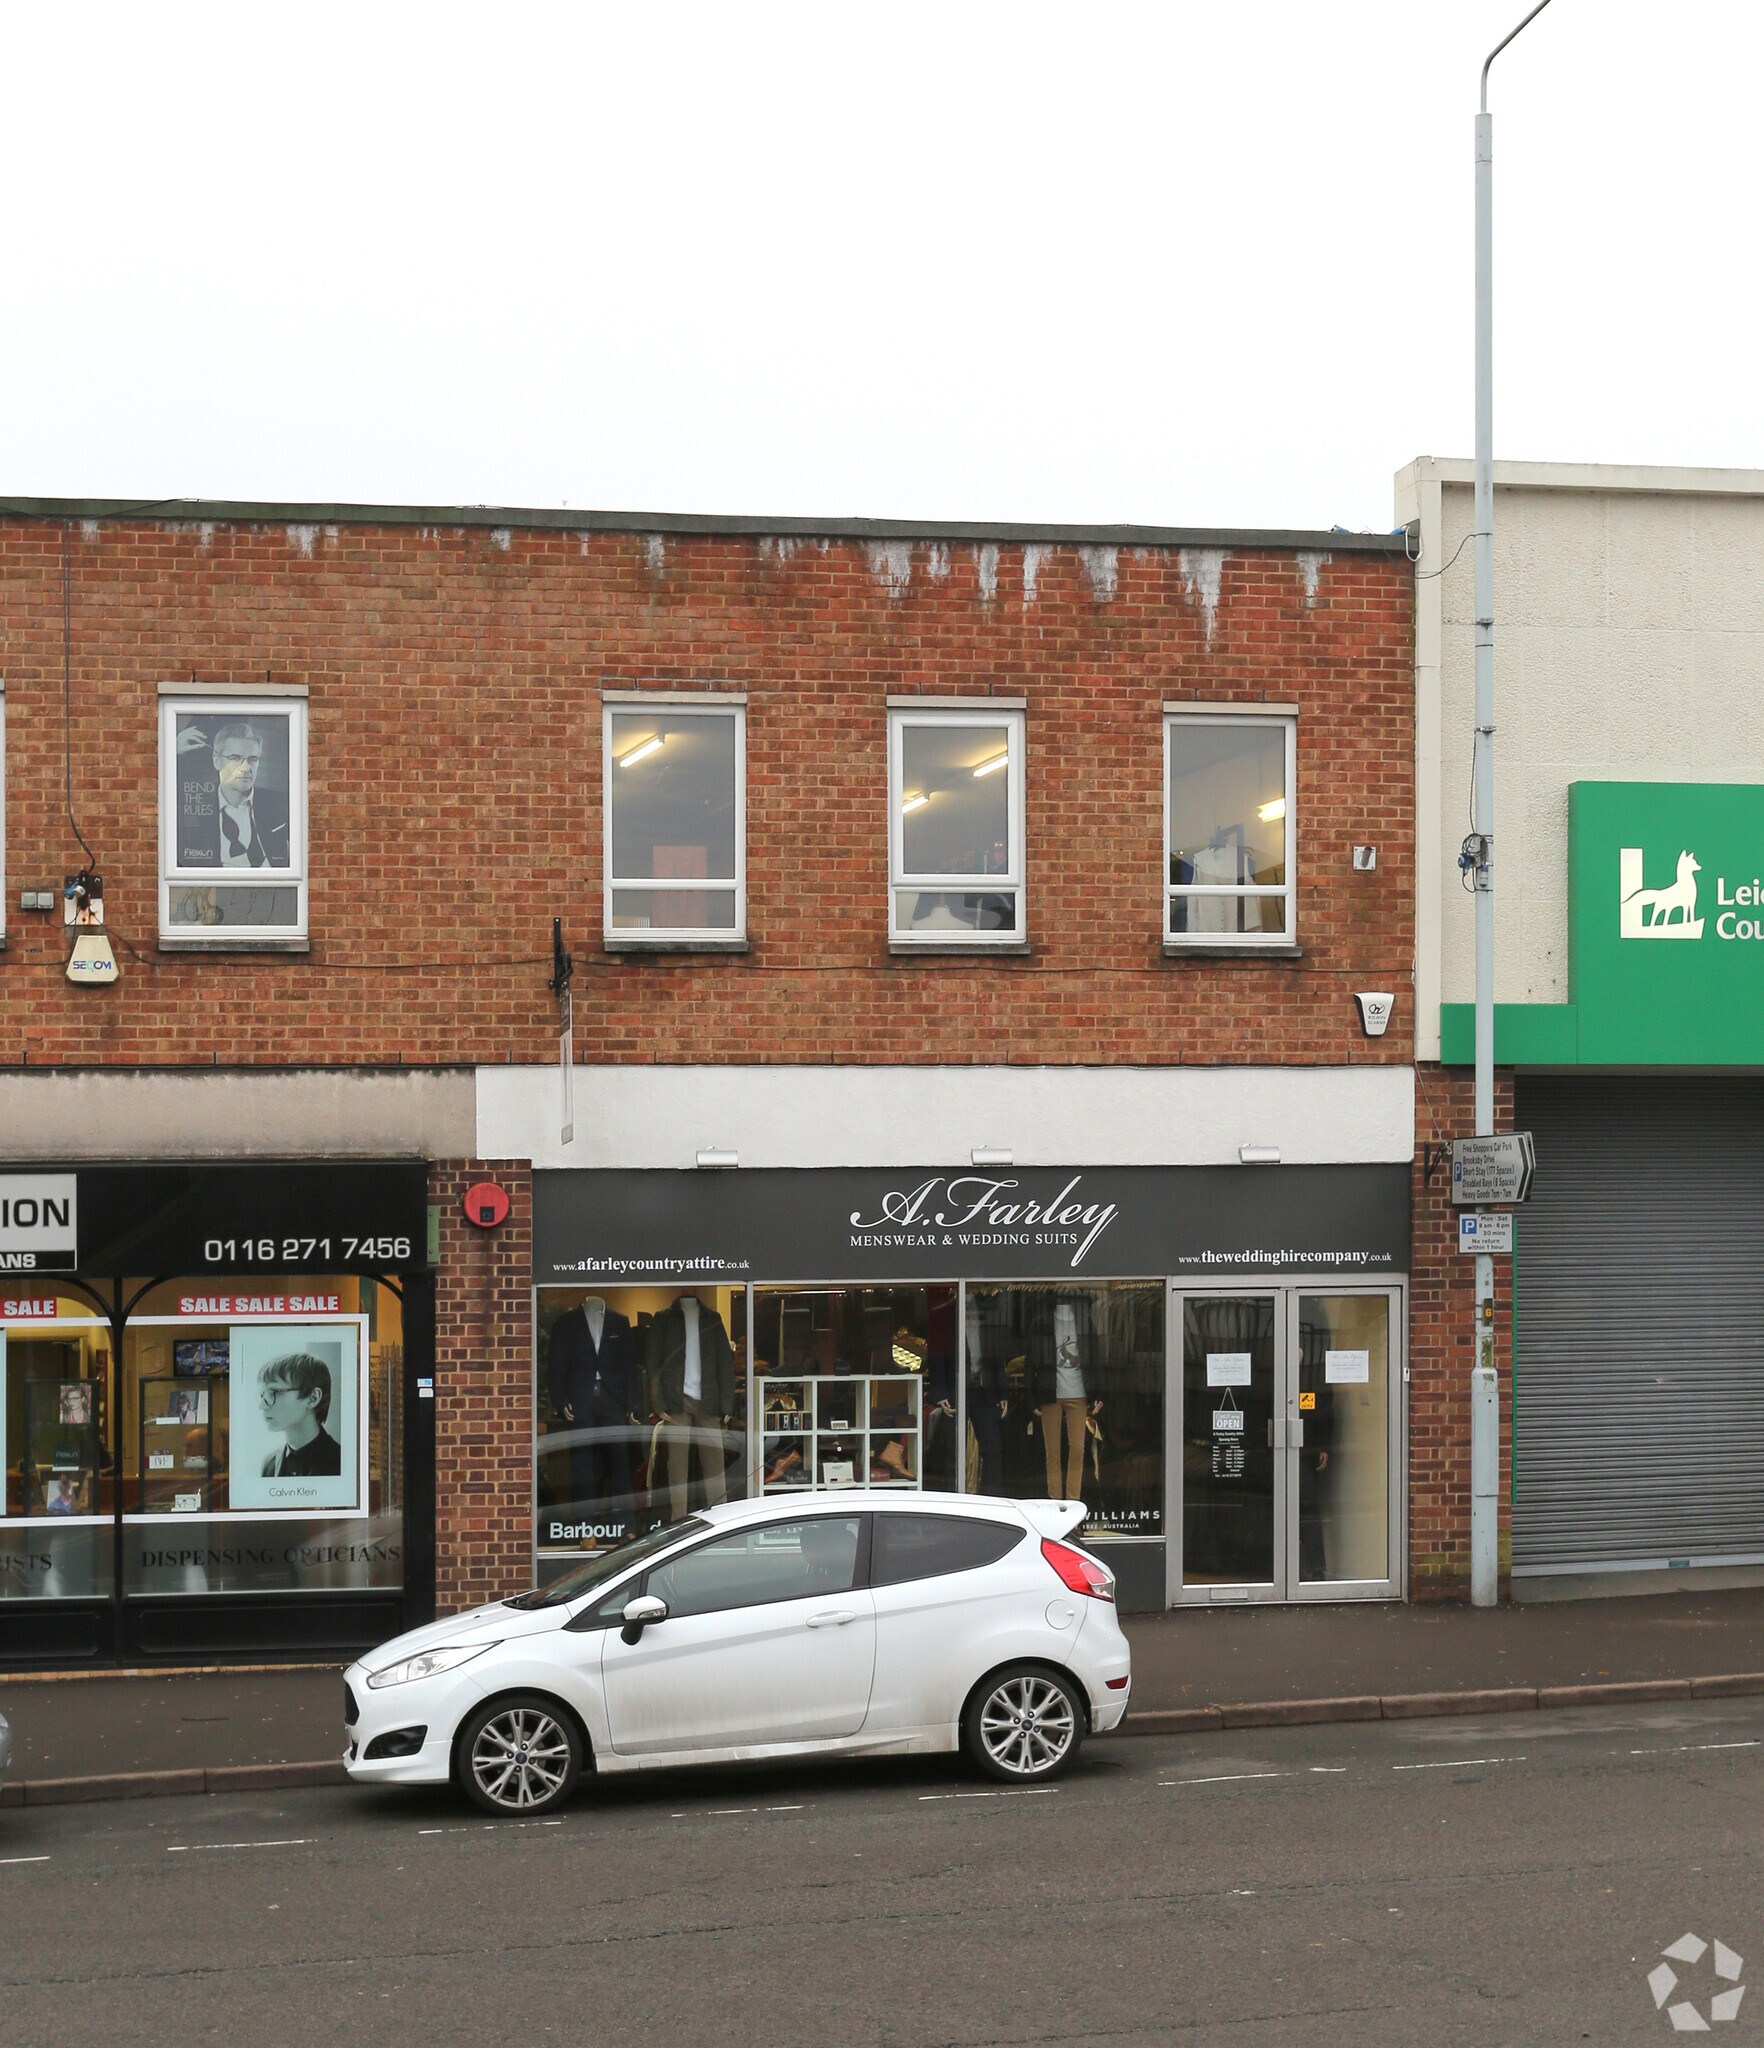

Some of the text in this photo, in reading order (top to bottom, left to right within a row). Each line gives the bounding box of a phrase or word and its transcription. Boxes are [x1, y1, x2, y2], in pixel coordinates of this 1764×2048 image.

[184, 782, 214, 792] BEND
[185, 793, 204, 804] THE
[184, 804, 213, 816] RULES
[73, 960, 112, 970] SECOM
[1462, 1144, 1472, 1152] Free
[1473, 1144, 1493, 1154] Shoppers
[1502, 1142, 1512, 1150] Park
[1463, 1155, 1494, 1165] Brooksby Drive
[1463, 1167, 1474, 1176] Short
[1476, 1166, 1485, 1177] Stay
[1496, 1164, 1514, 1175] Spaces)
[1462, 1179, 1481, 1188] Disabled
[1482, 1178, 1492, 1188] Bays
[1499, 1176, 1516, 1187] Spaces)
[1462, 1191, 1475, 1200] Heavy
[1476, 1190, 1490, 1199] Goods
[850, 1233, 1078, 1246] MENSWEAR & WEDDING SUITS
[204, 1237, 411, 1261] 0116 271 7456
[1178, 1250, 1392, 1265] www.theweddinghirecompany.co.uk
[553, 1256, 750, 1273] www.afarleycountryattire.co.uk
[4, 1300, 54, 1316] SALE
[181, 1296, 338, 1313] SALE SALE SALE
[1485, 1308, 1492, 1317] 6
[1216, 1420, 1240, 1428] OPEN
[269, 1487, 317, 1497] Calvin Klein
[550, 1522, 625, 1539] Barbour
[142, 1545, 400, 1567] DISPENSING OPTICIANS
[0, 1554, 52, 1571] ISTS
